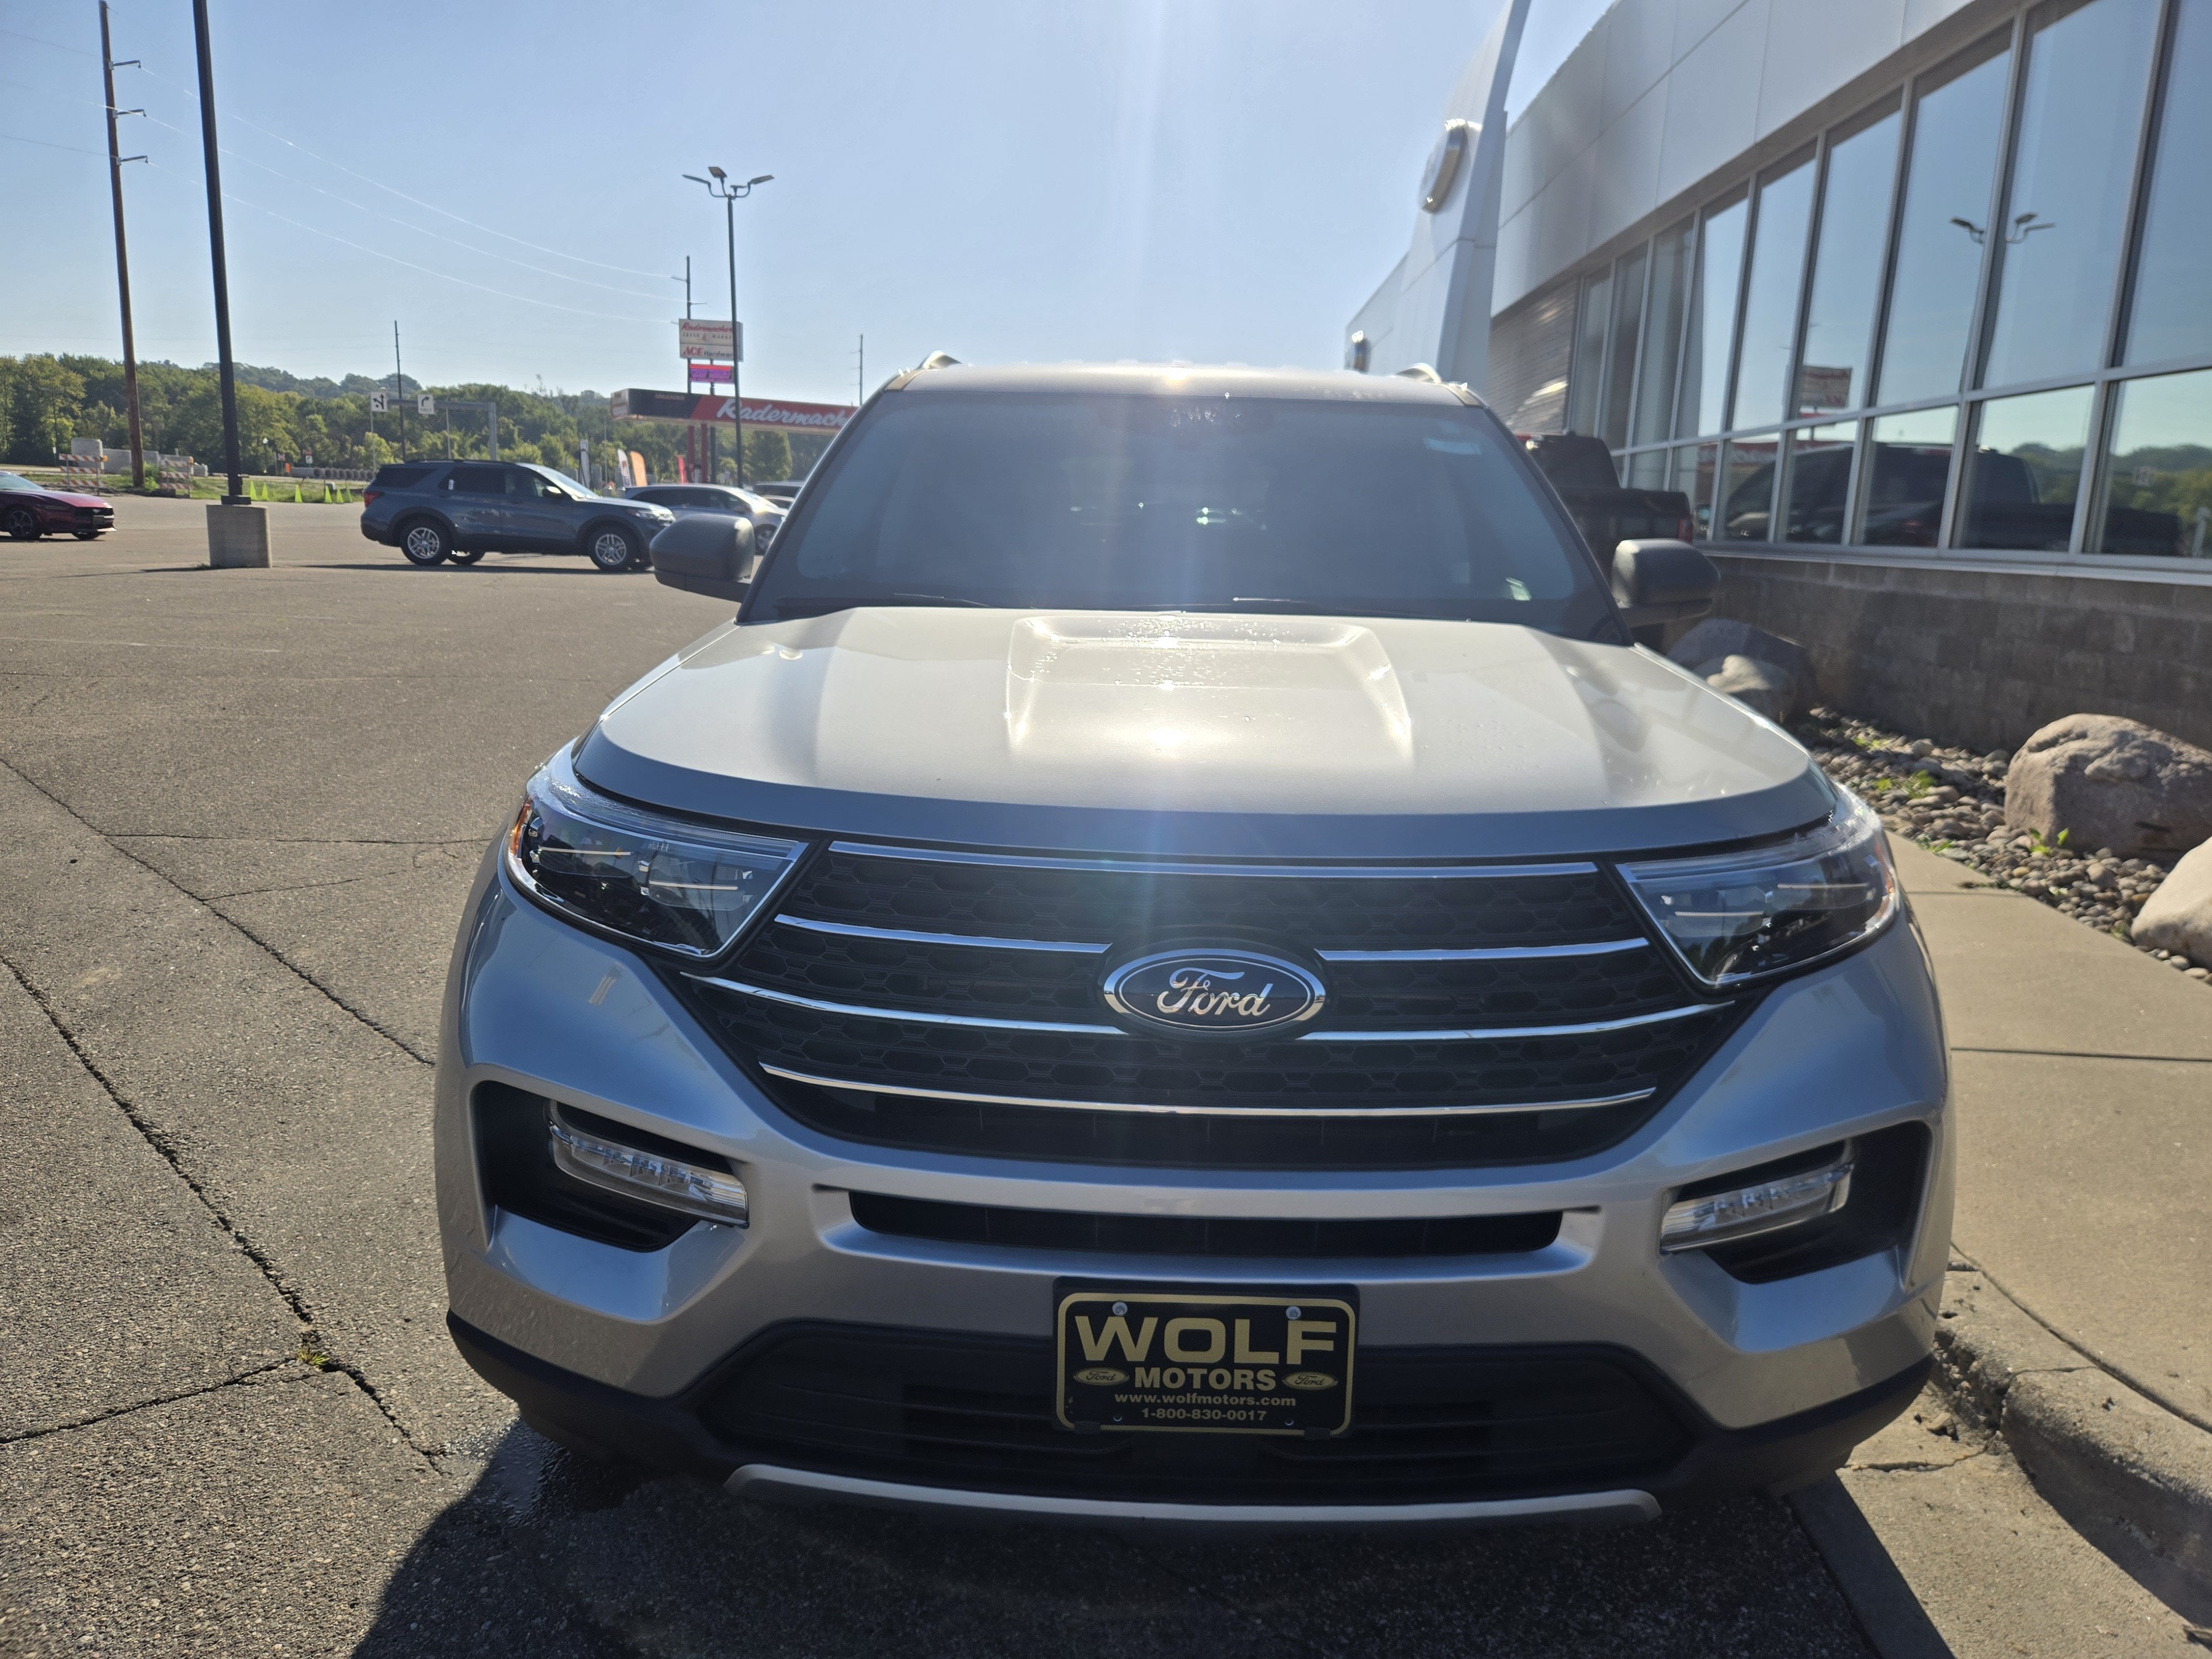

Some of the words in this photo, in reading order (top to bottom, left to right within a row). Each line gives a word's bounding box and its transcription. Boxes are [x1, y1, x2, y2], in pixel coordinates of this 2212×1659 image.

[682, 346, 703, 356] ACE
[716, 398, 848, 427] Radermach
[1156, 967, 1274, 1016] Ford
[1074, 1315, 1337, 1365] WOLF
[1085, 1370, 1117, 1382] Ford
[1134, 1366, 1276, 1391] MOTORS
[1294, 1374, 1326, 1386] Ford
[1114, 1392, 1296, 1406] www.wolfmotors.com
[1141, 1407, 1267, 1421] 1-800-830-0017
